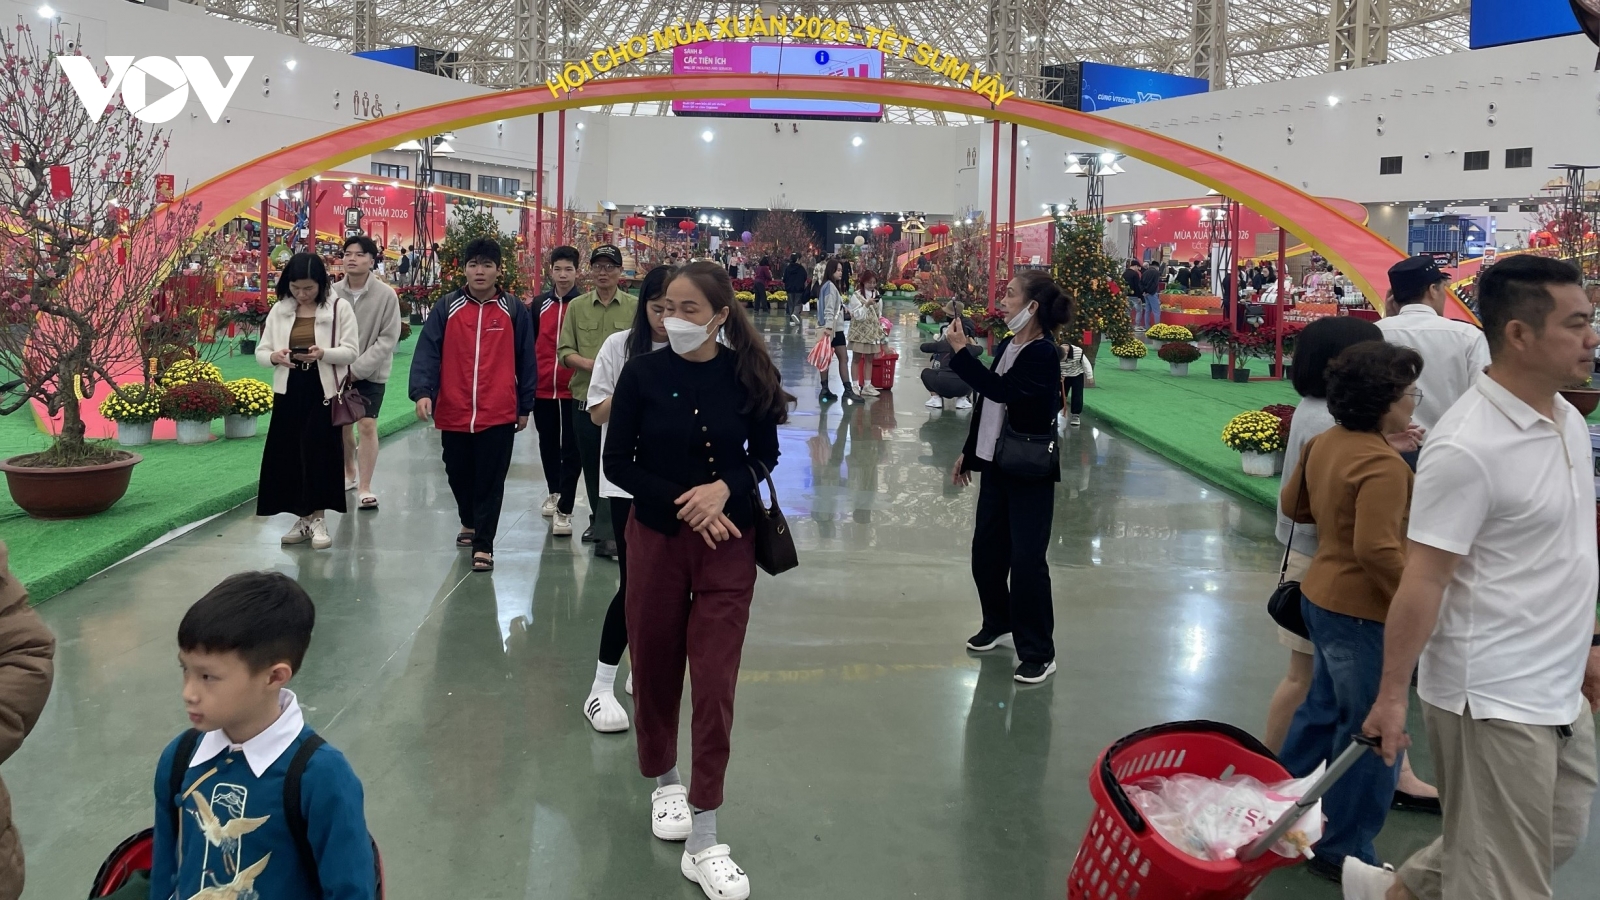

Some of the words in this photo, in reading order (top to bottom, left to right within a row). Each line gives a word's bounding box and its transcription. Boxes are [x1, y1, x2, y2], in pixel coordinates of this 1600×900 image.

[546, 60, 593, 98] HỘI
[592, 34, 648, 72] CHỢ
[653, 15, 712, 52] MÙA
[714, 8, 787, 38] XUÂN
[792, 16, 850, 42] 2026
[865, 24, 914, 58] TẾT
[913, 43, 970, 84] SUM
[971, 71, 1015, 106] VẦY
[684, 56, 697, 64] CÁC
[370, 196, 386, 207] CHỢ
[373, 205, 390, 217] NĂM
[391, 209, 408, 219] 2026
[1174, 229, 1191, 240] MÙA
